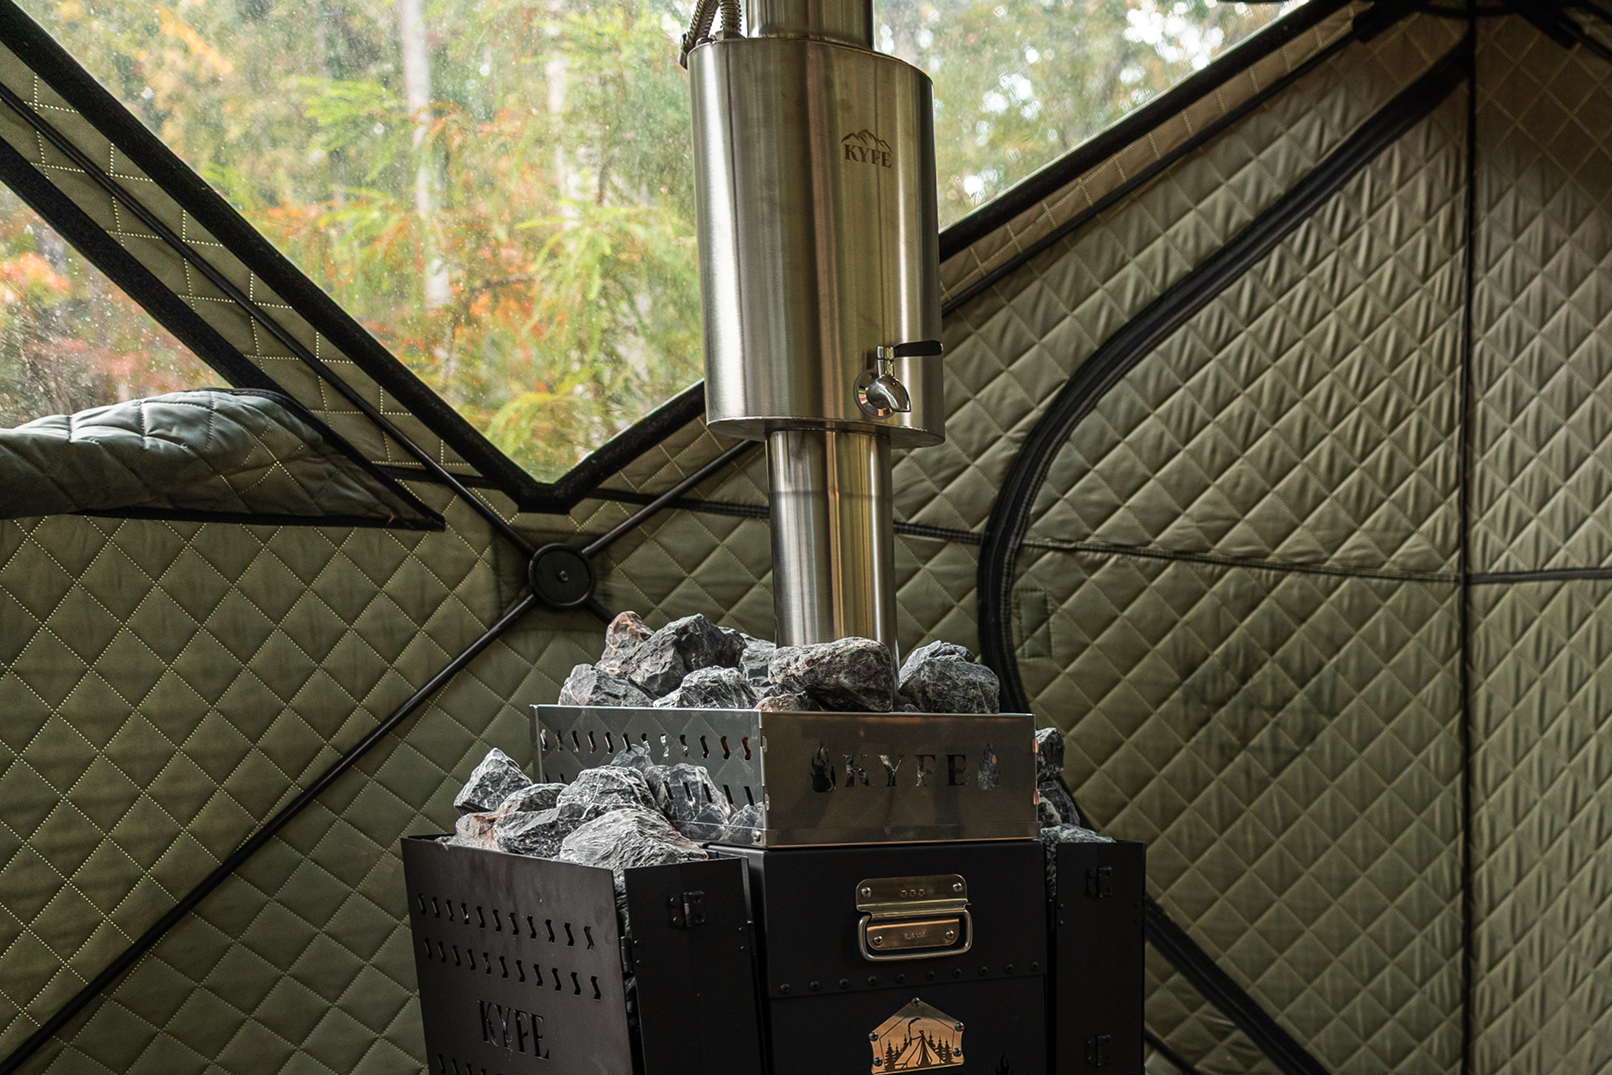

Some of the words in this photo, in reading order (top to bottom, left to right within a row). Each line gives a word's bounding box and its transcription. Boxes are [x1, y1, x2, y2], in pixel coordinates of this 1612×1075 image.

[844, 144, 892, 168] KYFE
[843, 754, 968, 788] KYFE
[477, 999, 550, 1062] KYFE
